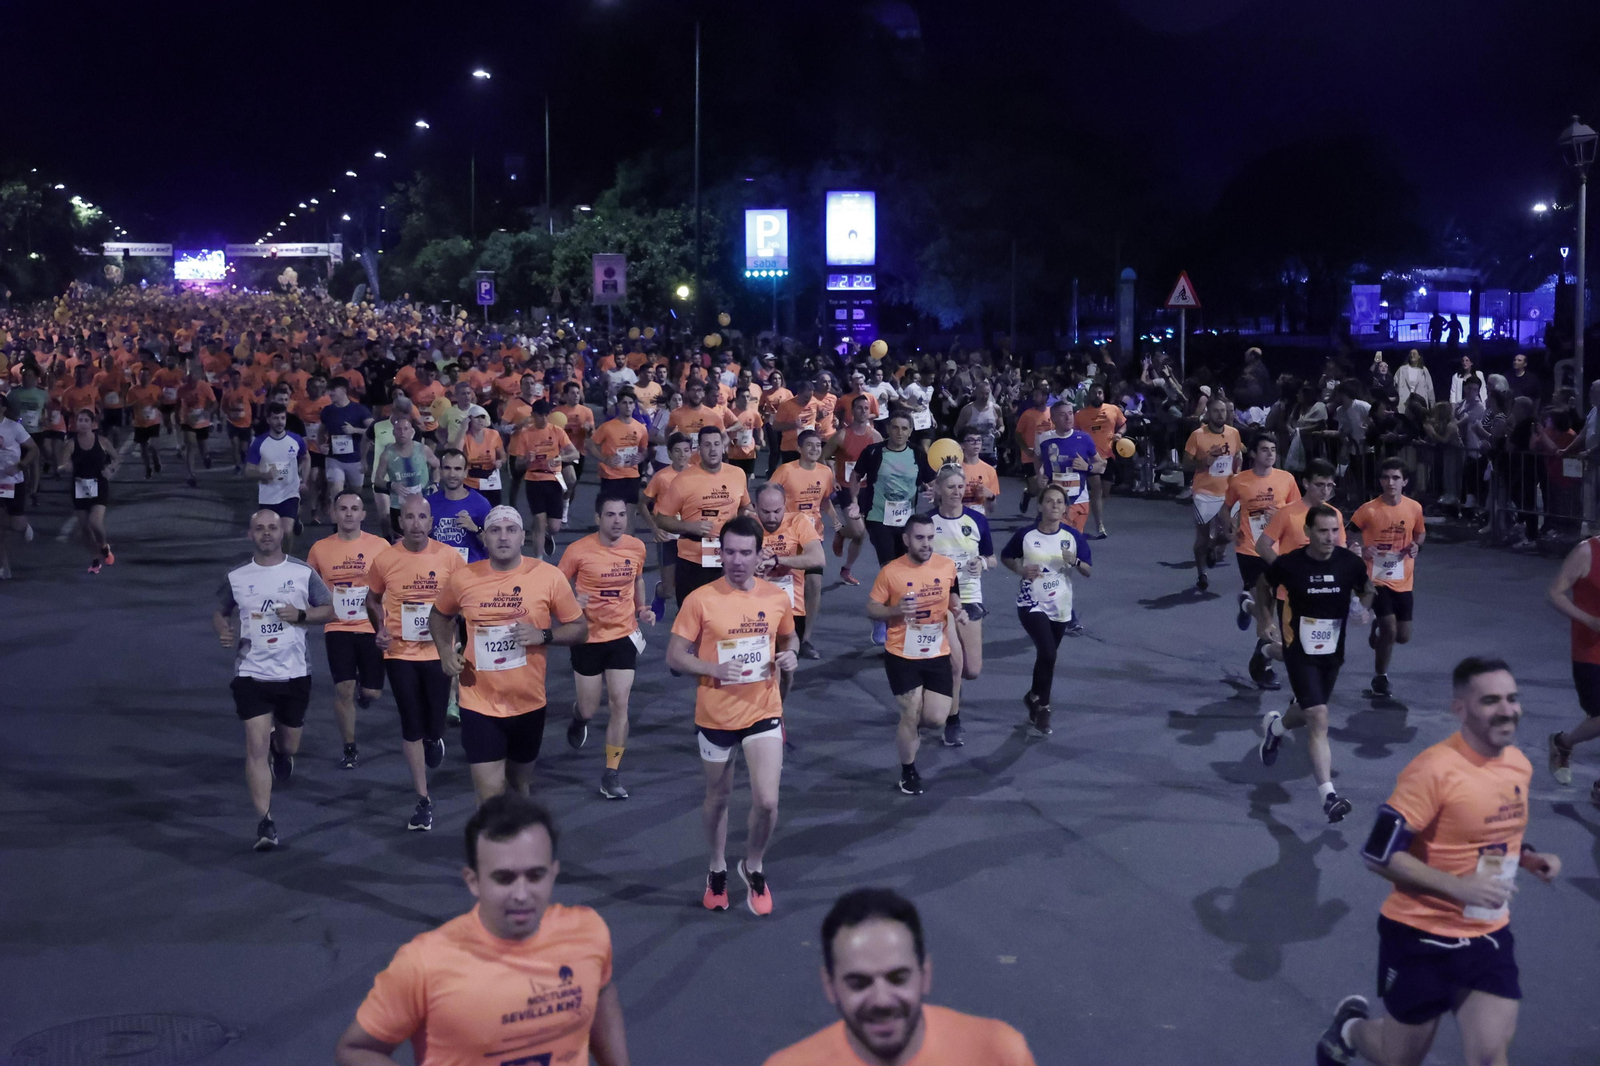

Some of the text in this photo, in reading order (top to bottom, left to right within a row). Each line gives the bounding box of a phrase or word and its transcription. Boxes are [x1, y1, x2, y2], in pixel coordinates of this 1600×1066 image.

[756, 215, 780, 249] P
[753, 259, 777, 268] saba
[480, 282, 491, 294] P
[341, 598, 365, 607] 11472
[260, 622, 284, 634] 8324
[917, 635, 936, 644] 3794
[1311, 630, 1331, 640] 5808
[484, 640, 516, 652] 12232
[527, 985, 582, 1005] NOCTURNA
[501, 1005, 554, 1025] SEVILLA
